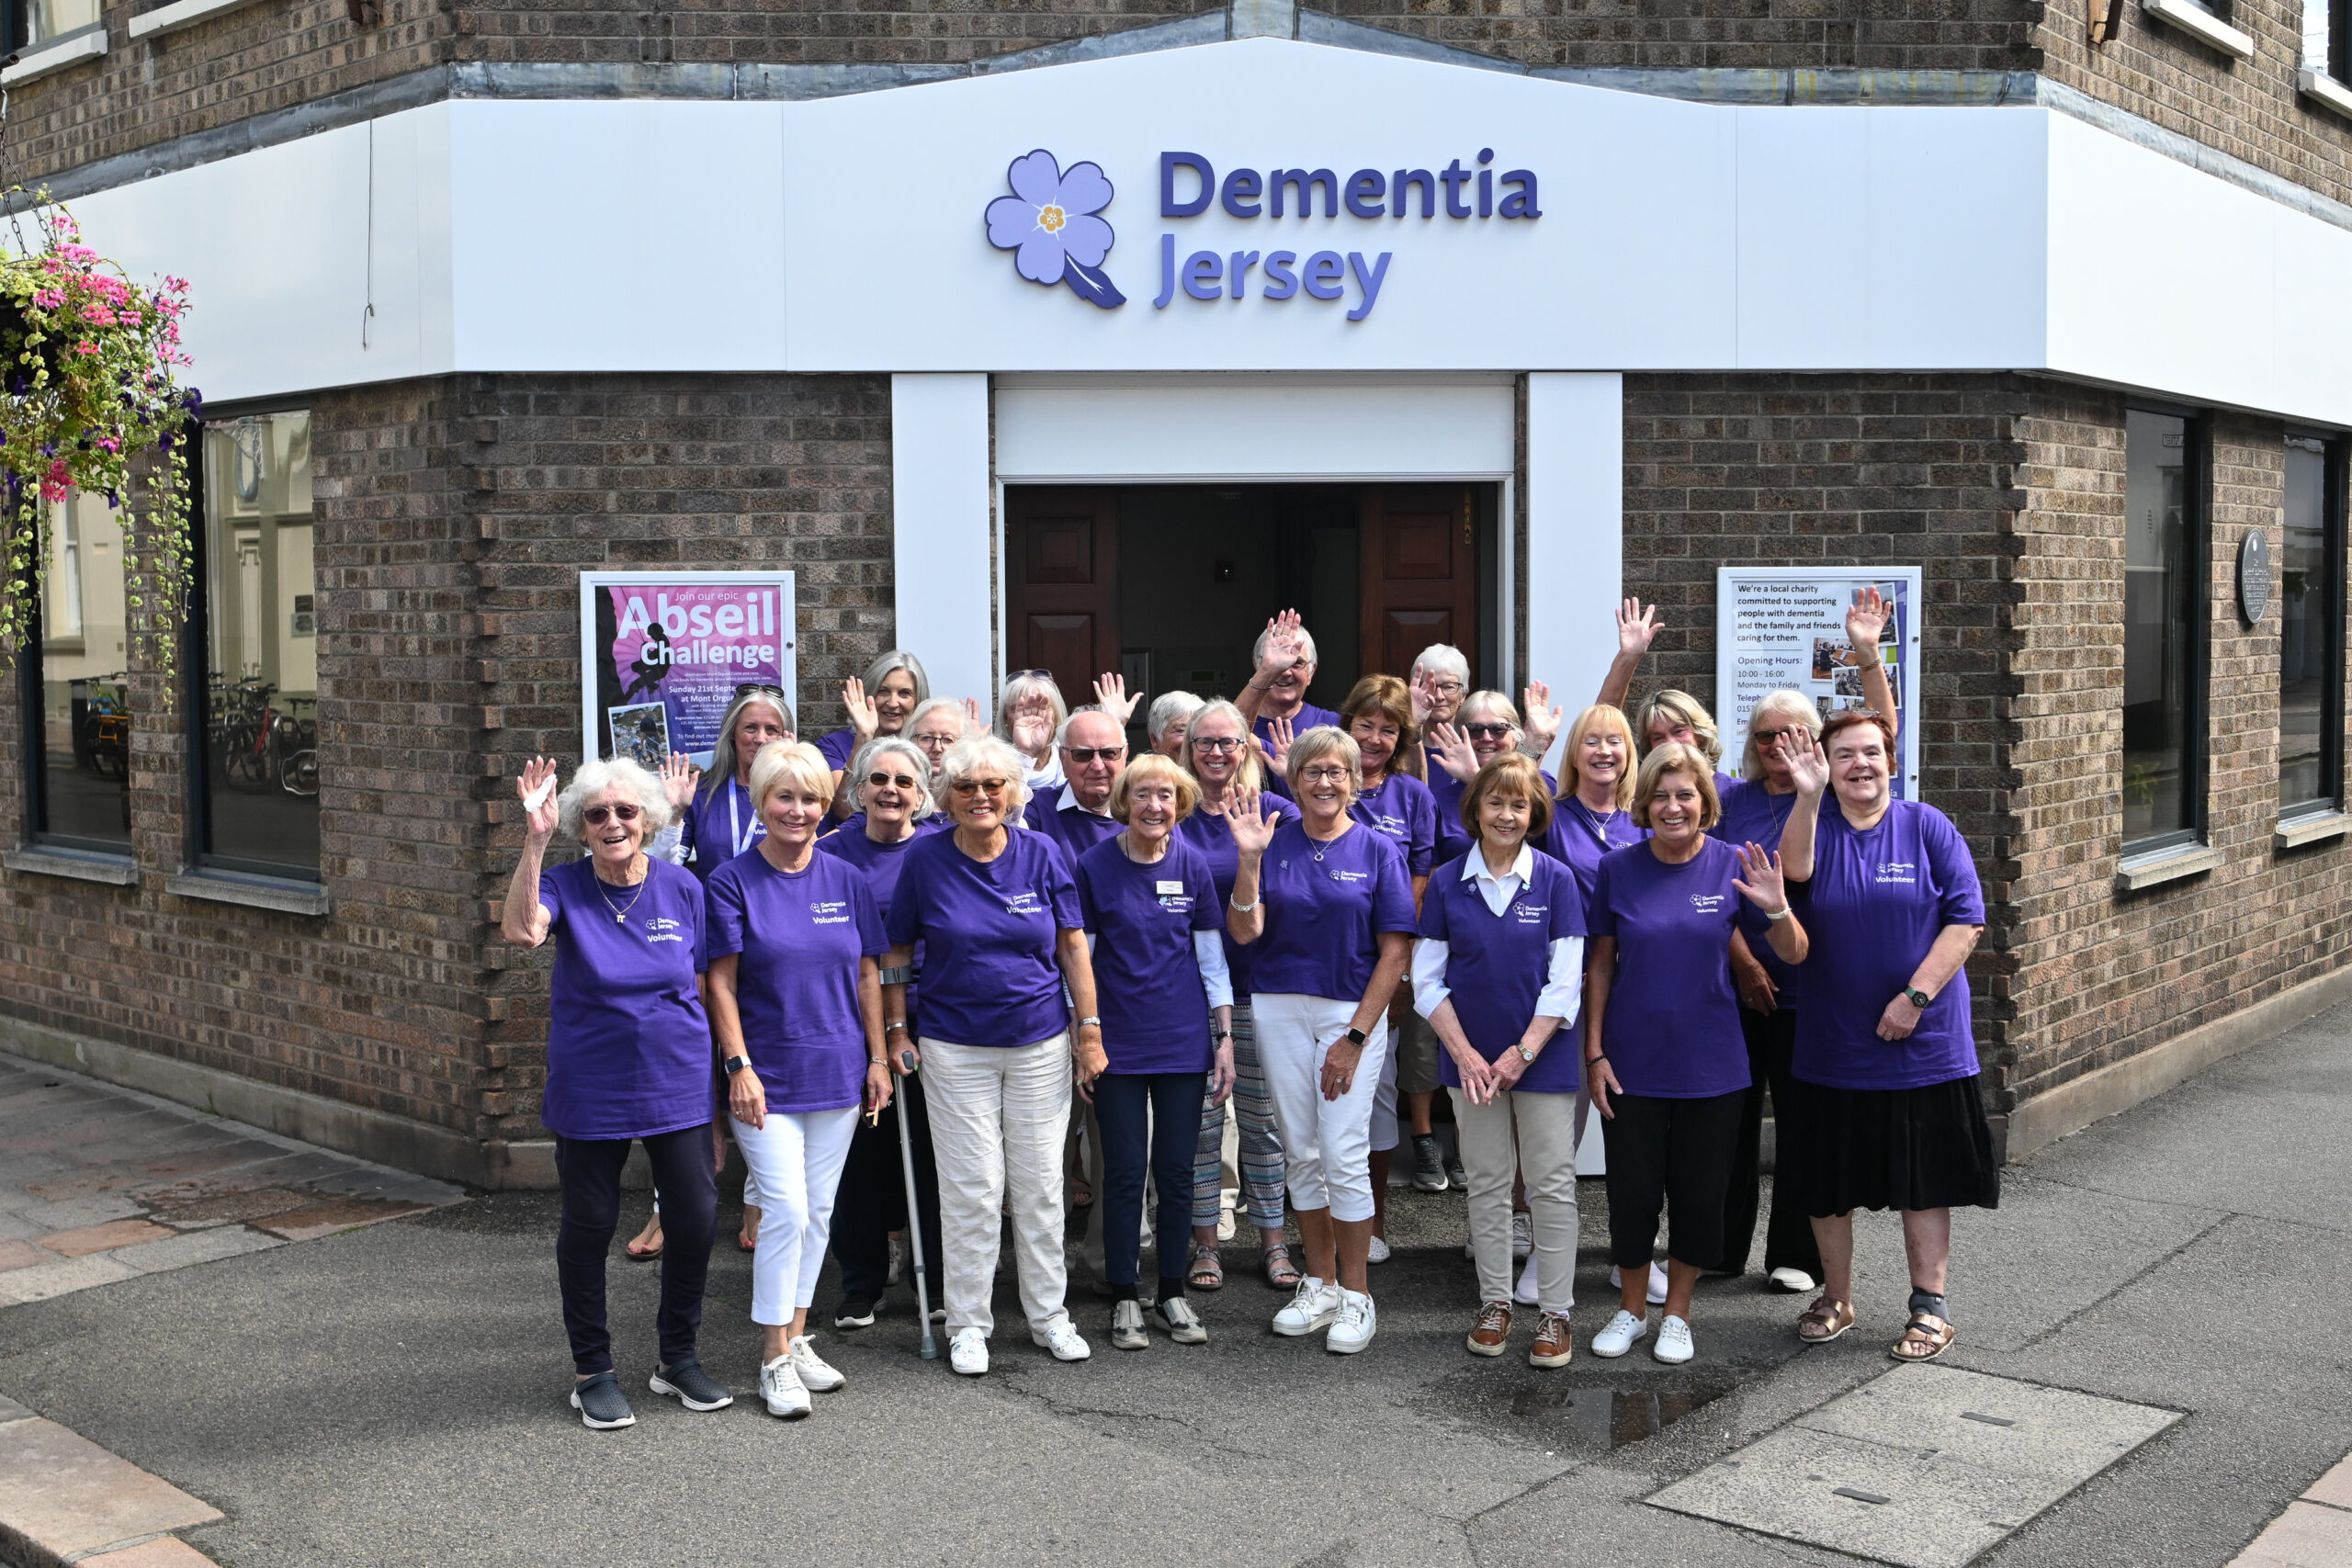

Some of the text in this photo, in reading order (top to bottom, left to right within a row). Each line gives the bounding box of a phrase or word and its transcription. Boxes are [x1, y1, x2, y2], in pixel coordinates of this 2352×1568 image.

[1160, 148, 1543, 220] Dementia
[1153, 233, 1393, 321] Jersey
[1738, 584, 1761, 592] We're
[1770, 584, 1789, 592] local
[1791, 584, 1818, 594] charity
[675, 592, 739, 603] Join our epic
[1737, 597, 1781, 605] committed
[1793, 597, 1837, 606] supporting
[617, 591, 774, 638] Abseil
[1737, 609, 1825, 618] people with dementia
[1770, 621, 1794, 630] family
[1813, 621, 1841, 629] friends
[1737, 634, 1761, 643] caring
[640, 639, 775, 669] Challenge
[1737, 656, 1773, 666] Opening
[668, 685, 695, 694] Sunday
[715, 684, 736, 694] Septe
[1737, 694, 1763, 703] Teleph
[1372, 824, 1404, 836] Volunteer
[812, 916, 850, 924] Volunteer
[647, 933, 683, 942] Volunteer
